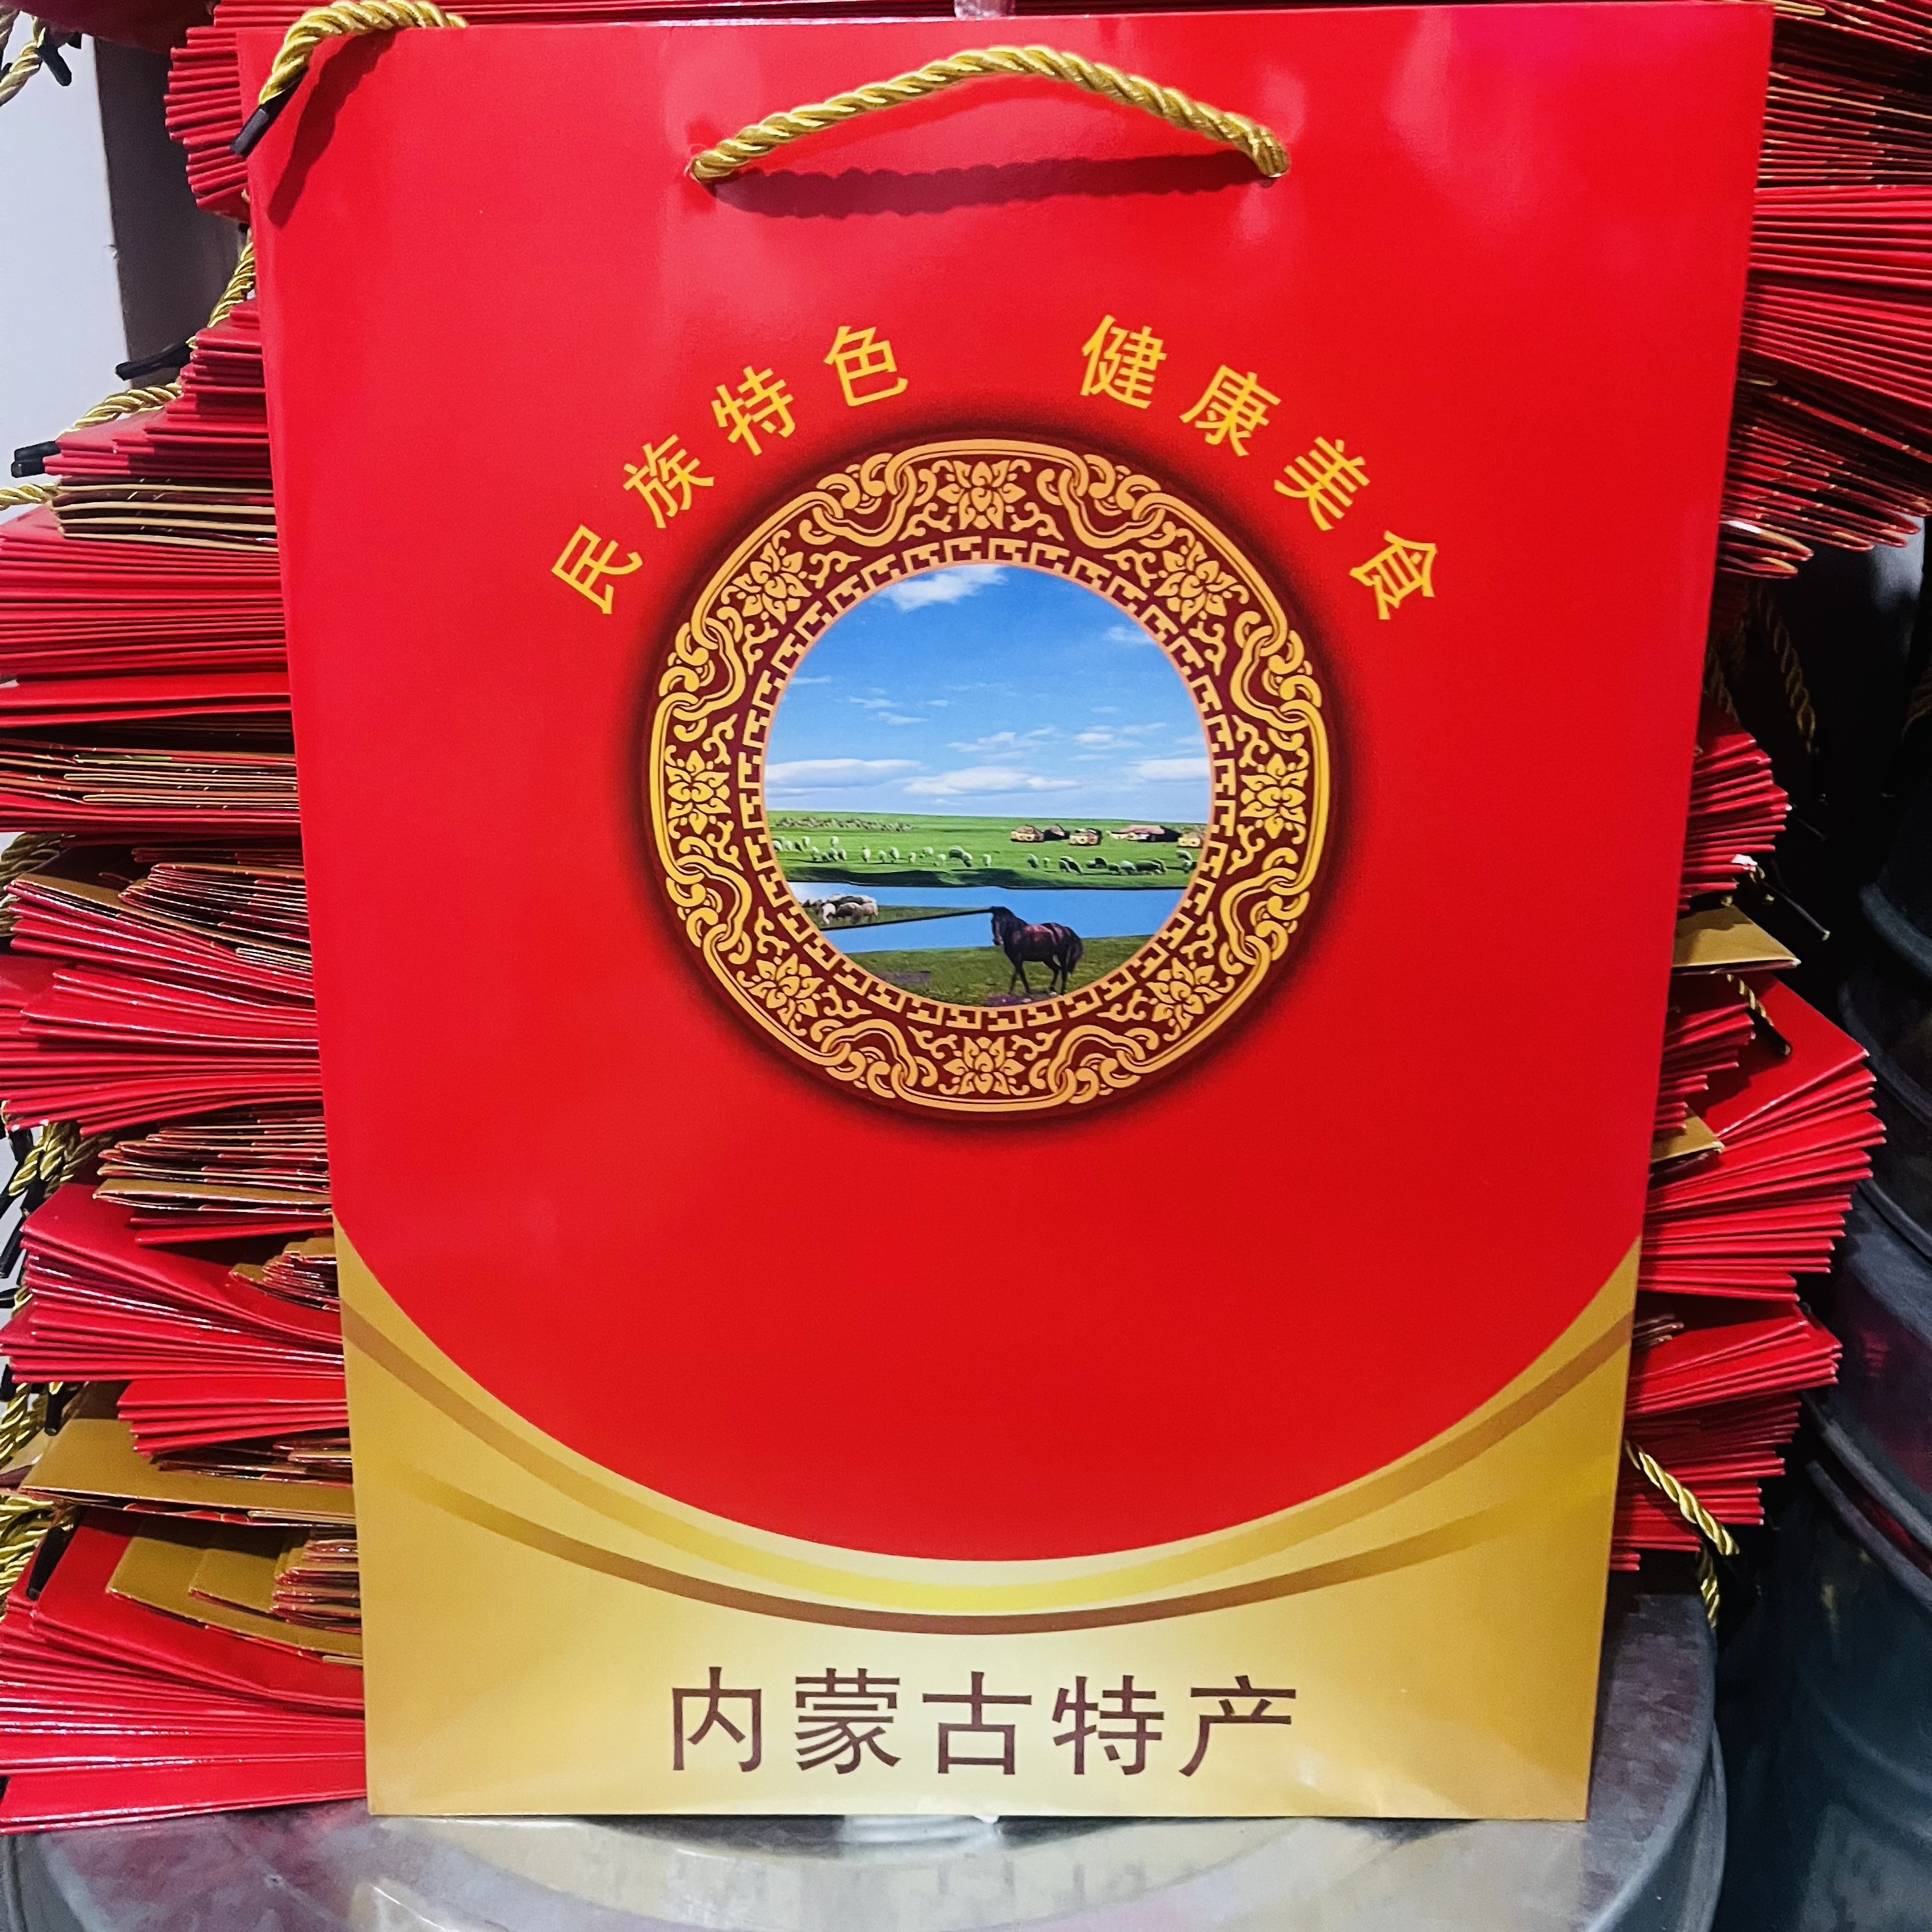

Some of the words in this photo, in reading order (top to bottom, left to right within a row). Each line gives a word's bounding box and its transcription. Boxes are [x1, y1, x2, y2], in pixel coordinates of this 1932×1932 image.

[551, 325, 908, 615] 民族特色
[1081, 314, 1438, 620] 健康美食
[671, 1666, 1299, 1777] 内蒙古特产
